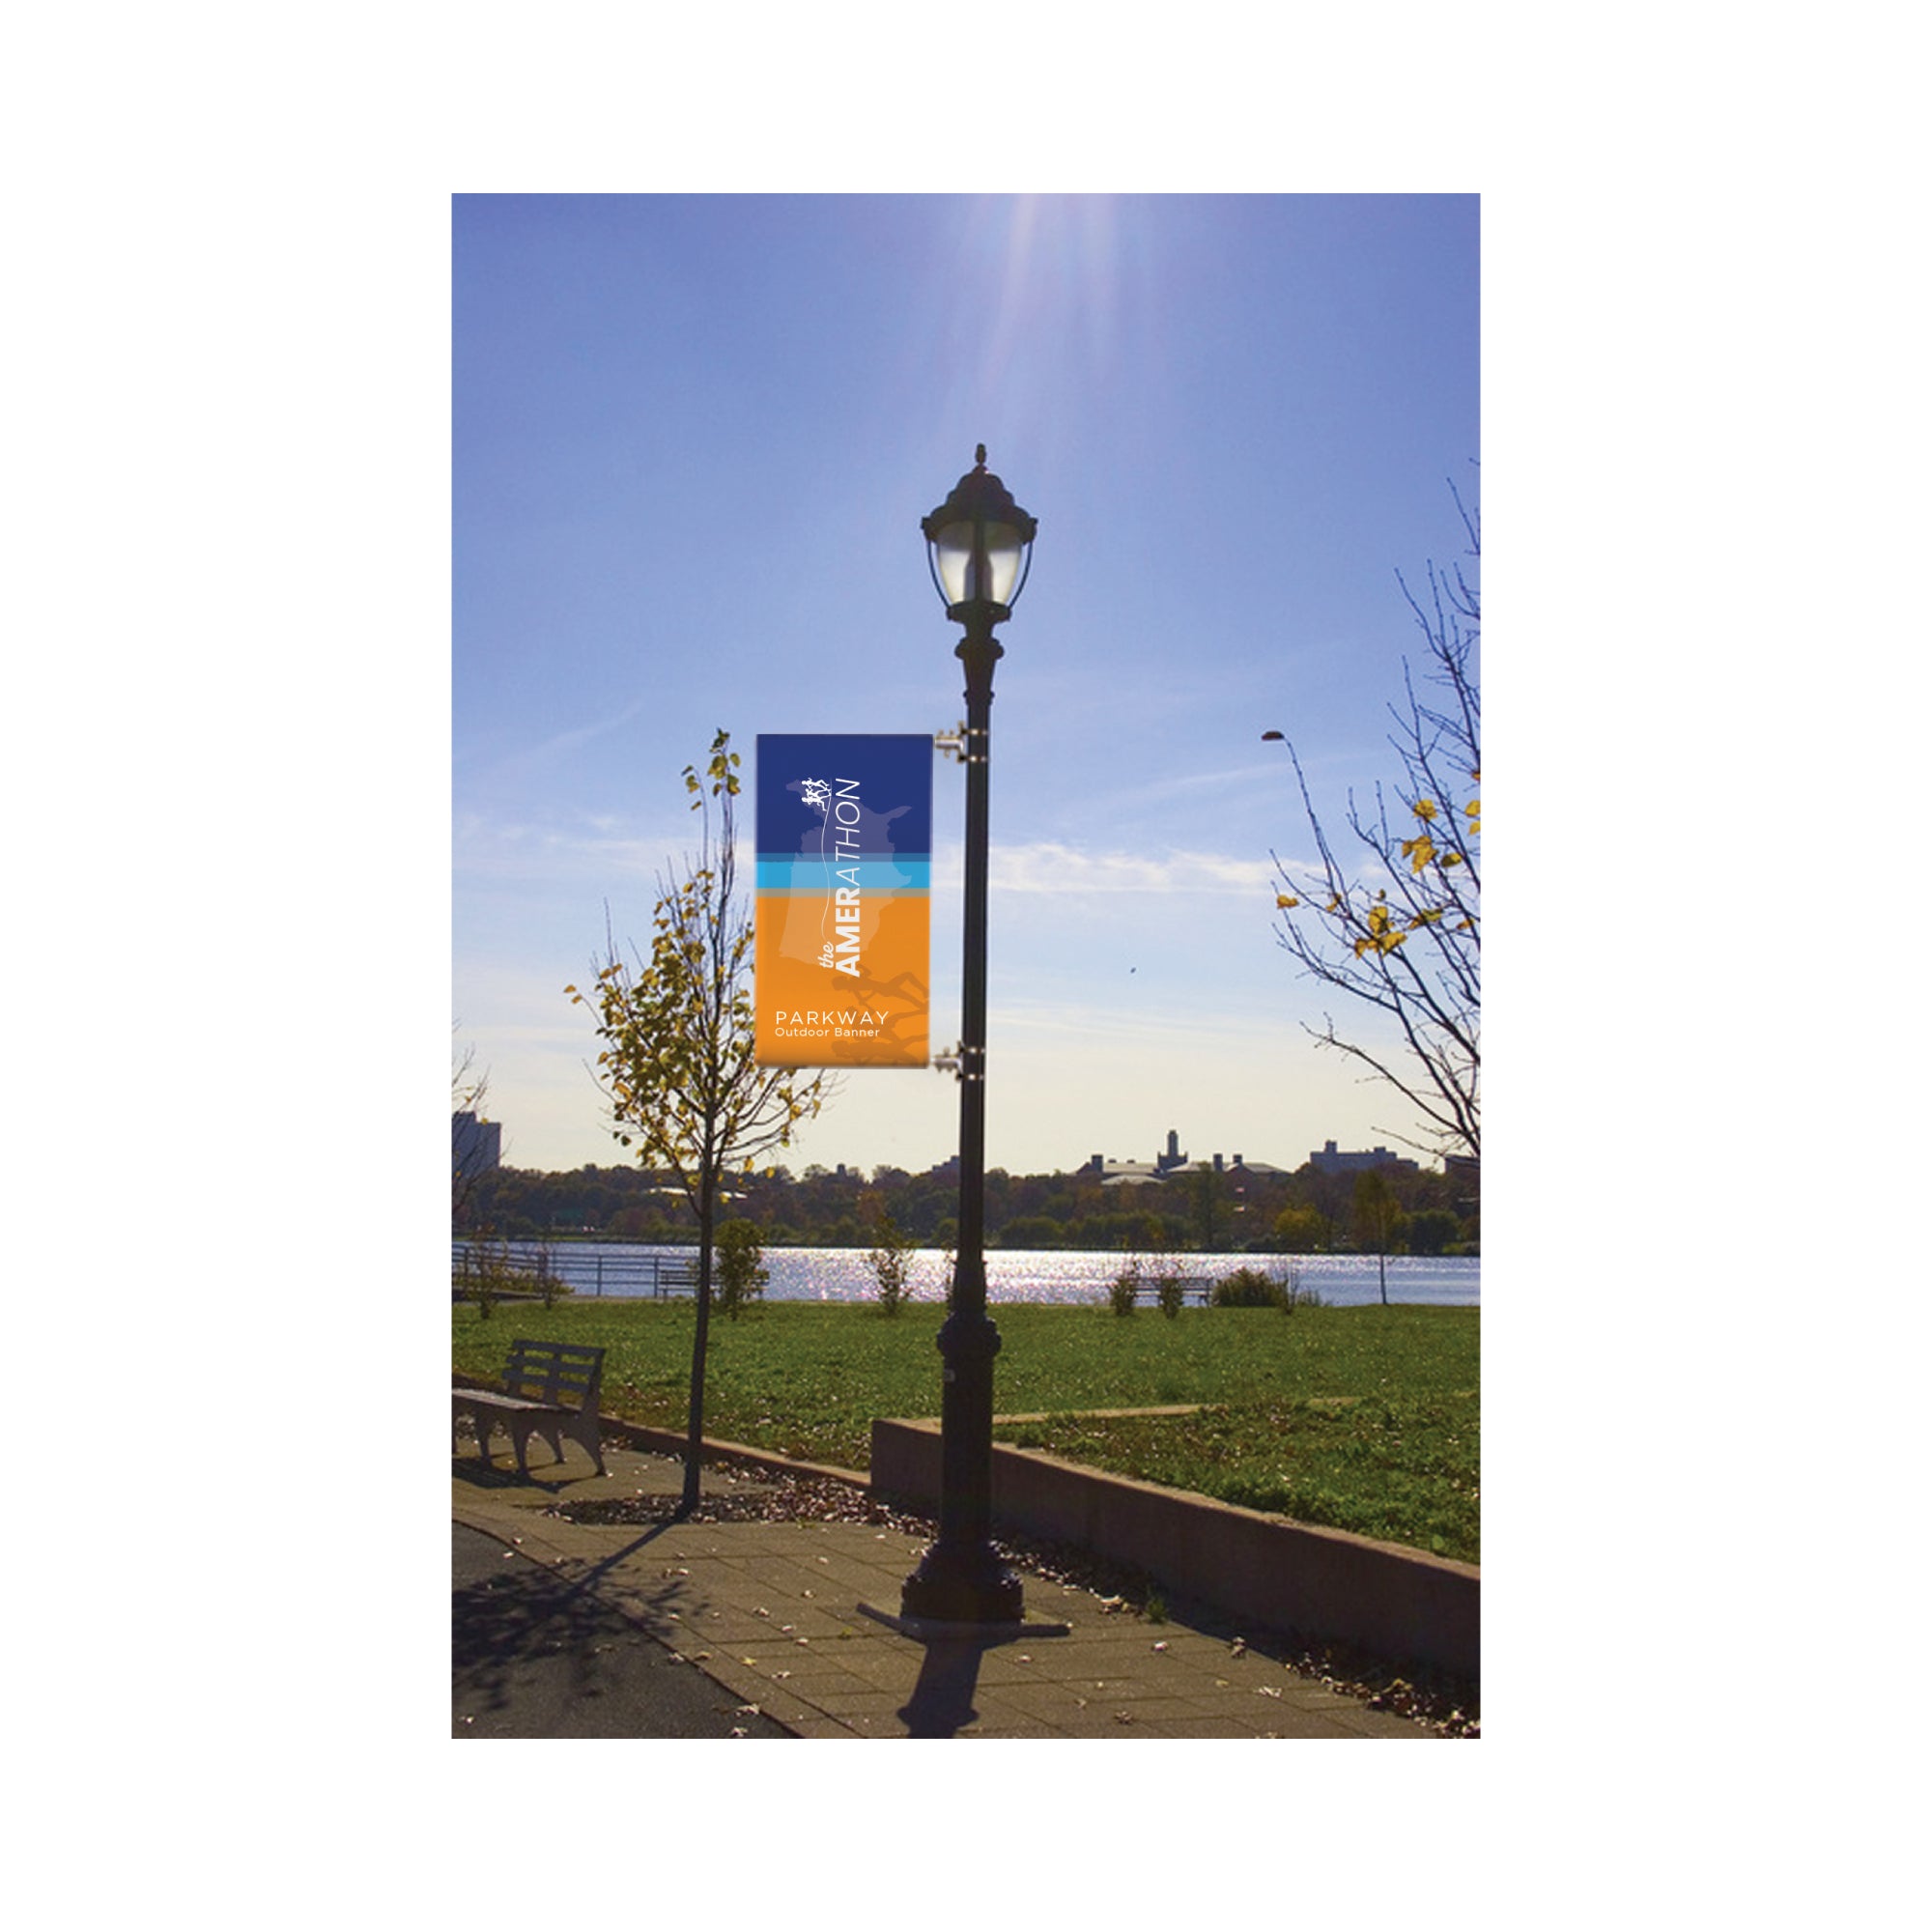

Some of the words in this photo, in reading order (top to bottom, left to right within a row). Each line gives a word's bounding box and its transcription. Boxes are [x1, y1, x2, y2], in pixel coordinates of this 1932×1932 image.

[836, 779, 861, 978] AMERATHON
[817, 941, 834, 968] the
[776, 1010, 889, 1025] PARKWAY
[775, 1027, 830, 1037] Outdoor
[835, 1027, 880, 1037] Banner
